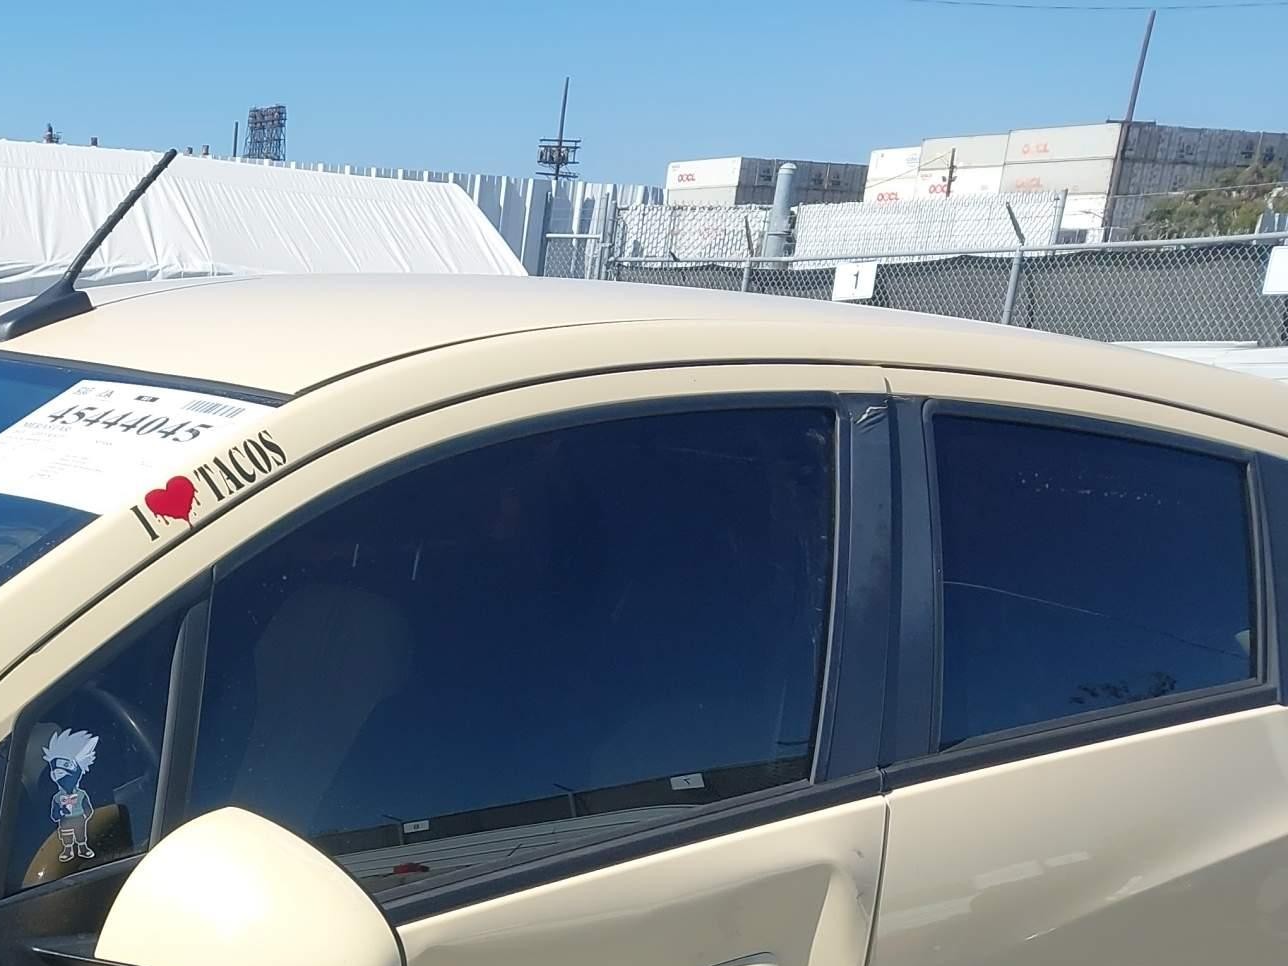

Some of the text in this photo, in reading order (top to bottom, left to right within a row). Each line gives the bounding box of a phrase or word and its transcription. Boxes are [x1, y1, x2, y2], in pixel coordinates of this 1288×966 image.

[853, 269, 860, 290] 1
[47, 404, 214, 442] 45444045
[130, 430, 287, 541] I TACOS
